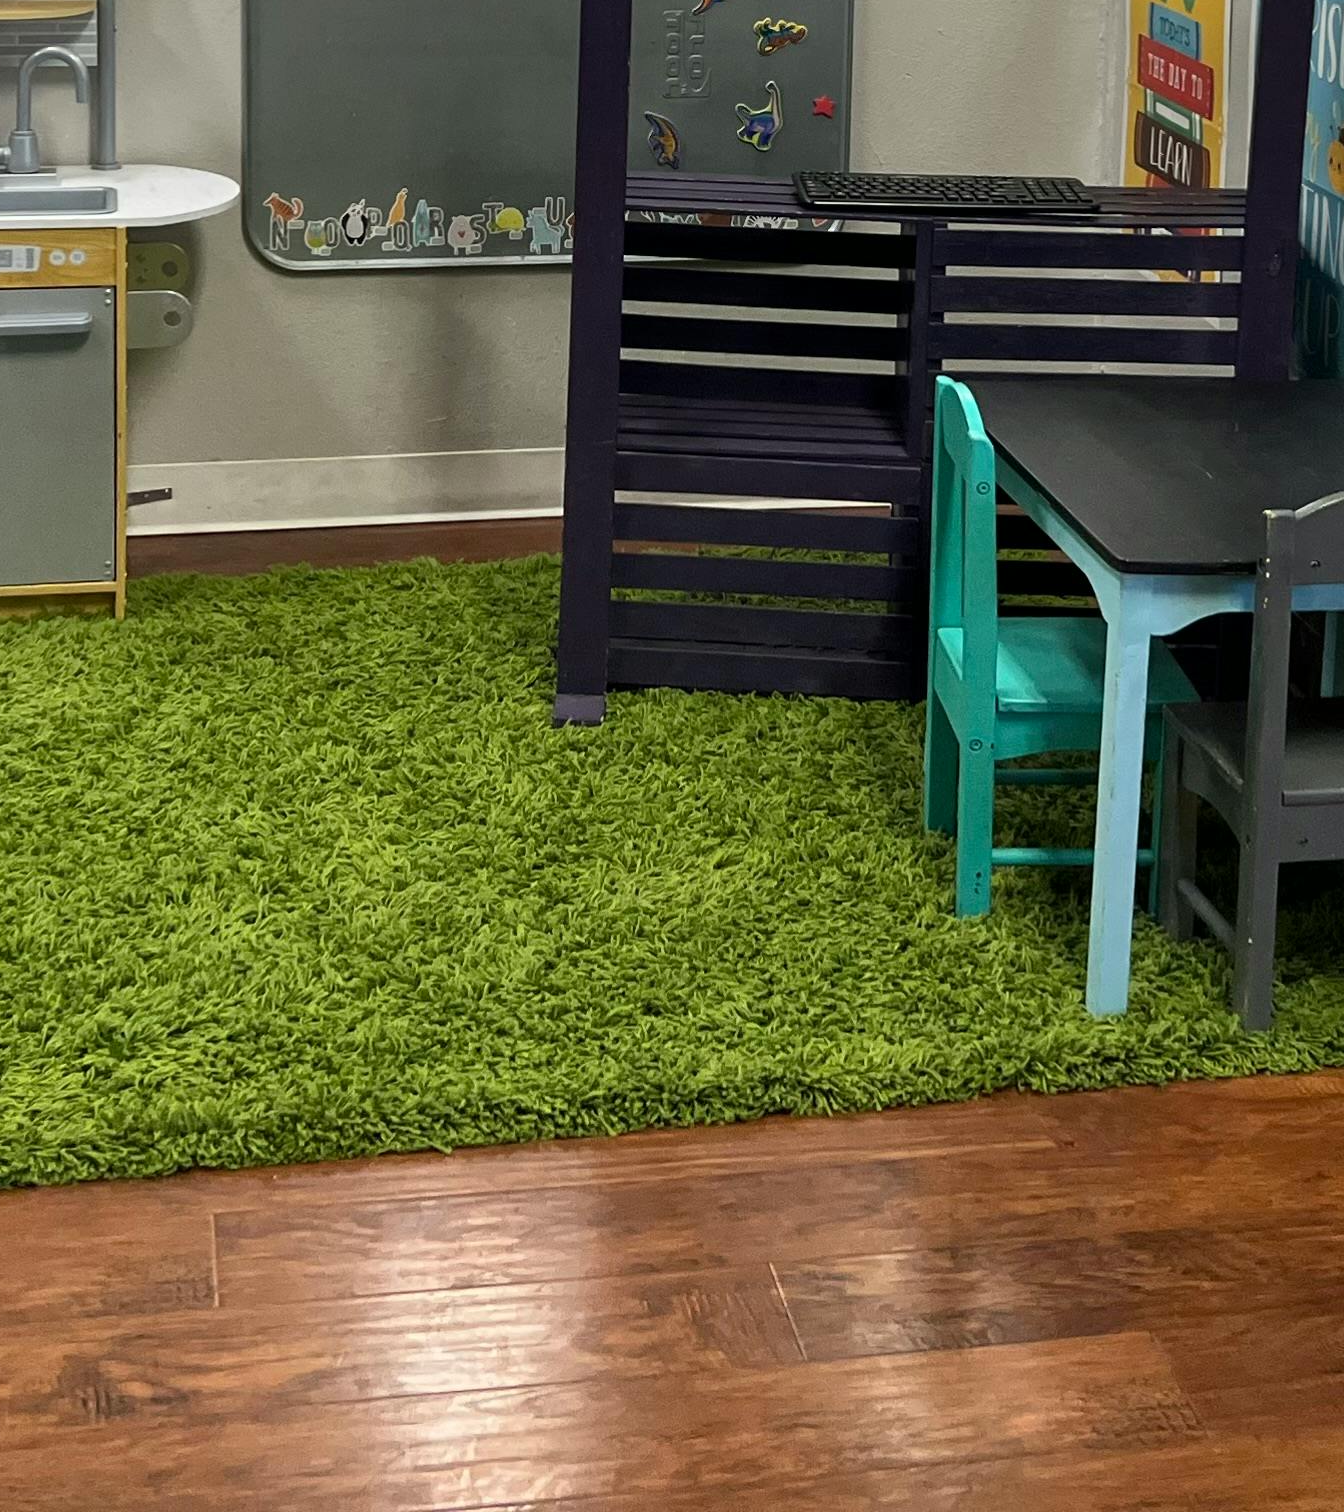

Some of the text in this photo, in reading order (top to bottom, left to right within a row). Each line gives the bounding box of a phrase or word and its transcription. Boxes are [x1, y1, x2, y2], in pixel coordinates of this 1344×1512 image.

[1147, 53, 1204, 101] THE DAY TO
[1149, 126, 1194, 186] LEARN
